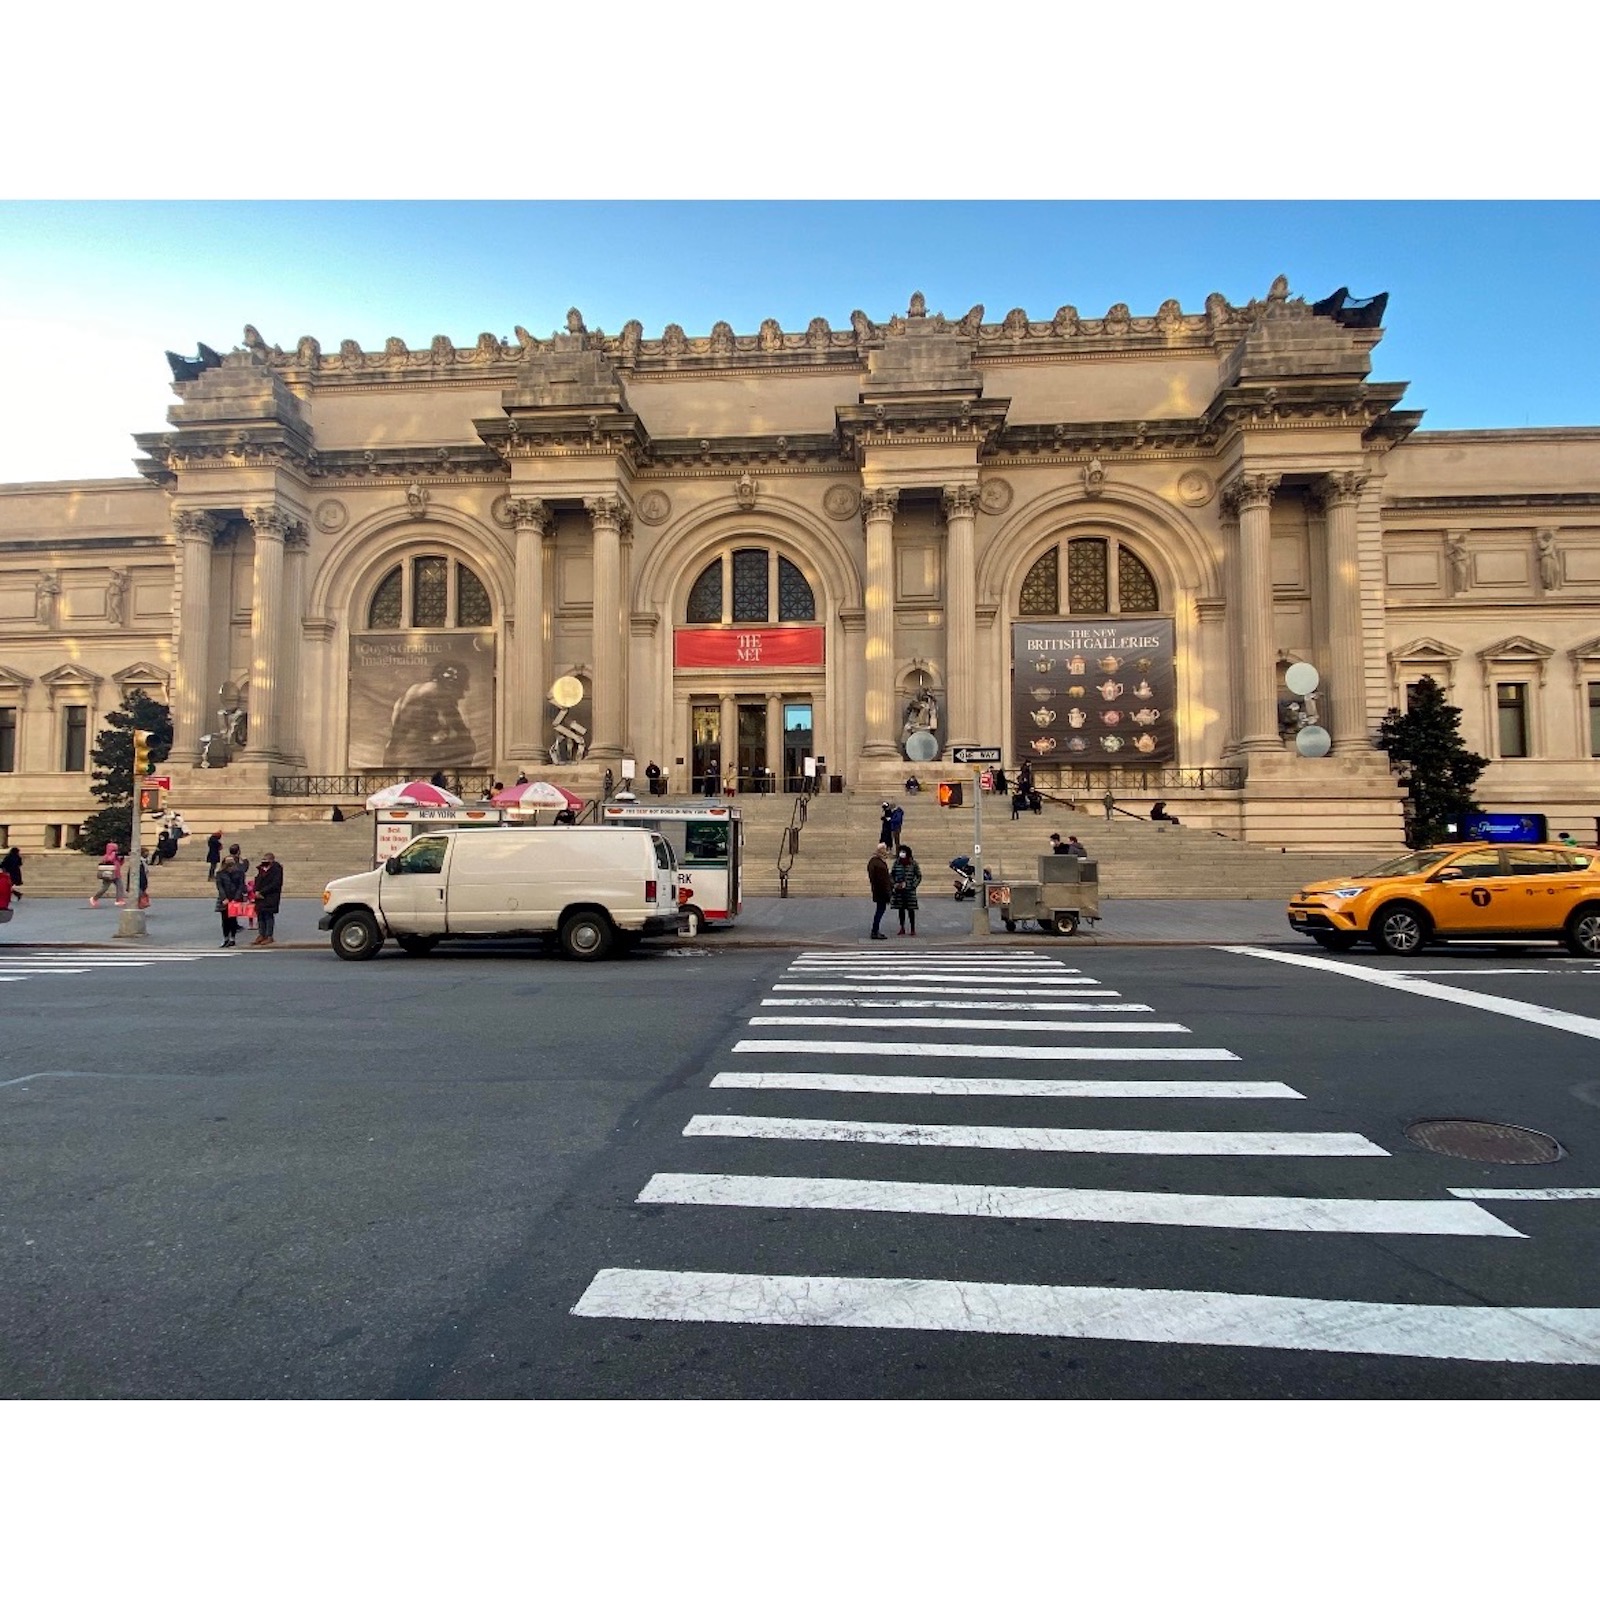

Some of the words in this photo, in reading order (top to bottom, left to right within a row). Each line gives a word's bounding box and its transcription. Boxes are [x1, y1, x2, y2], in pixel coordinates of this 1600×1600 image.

[1070, 629, 1090, 638] THE
[1093, 628, 1117, 638] NEW
[737, 633, 762, 648] THE
[1027, 639, 1081, 650] BRITISH
[1083, 636, 1160, 649] GALLERIES
[397, 642, 443, 655] Graphic
[361, 655, 428, 667] Imagination
[736, 648, 763, 662] MET
[980, 751, 995, 759] WAY
[419, 810, 436, 819] NEW
[437, 810, 456, 819] YORK
[678, 873, 692, 883] RK
